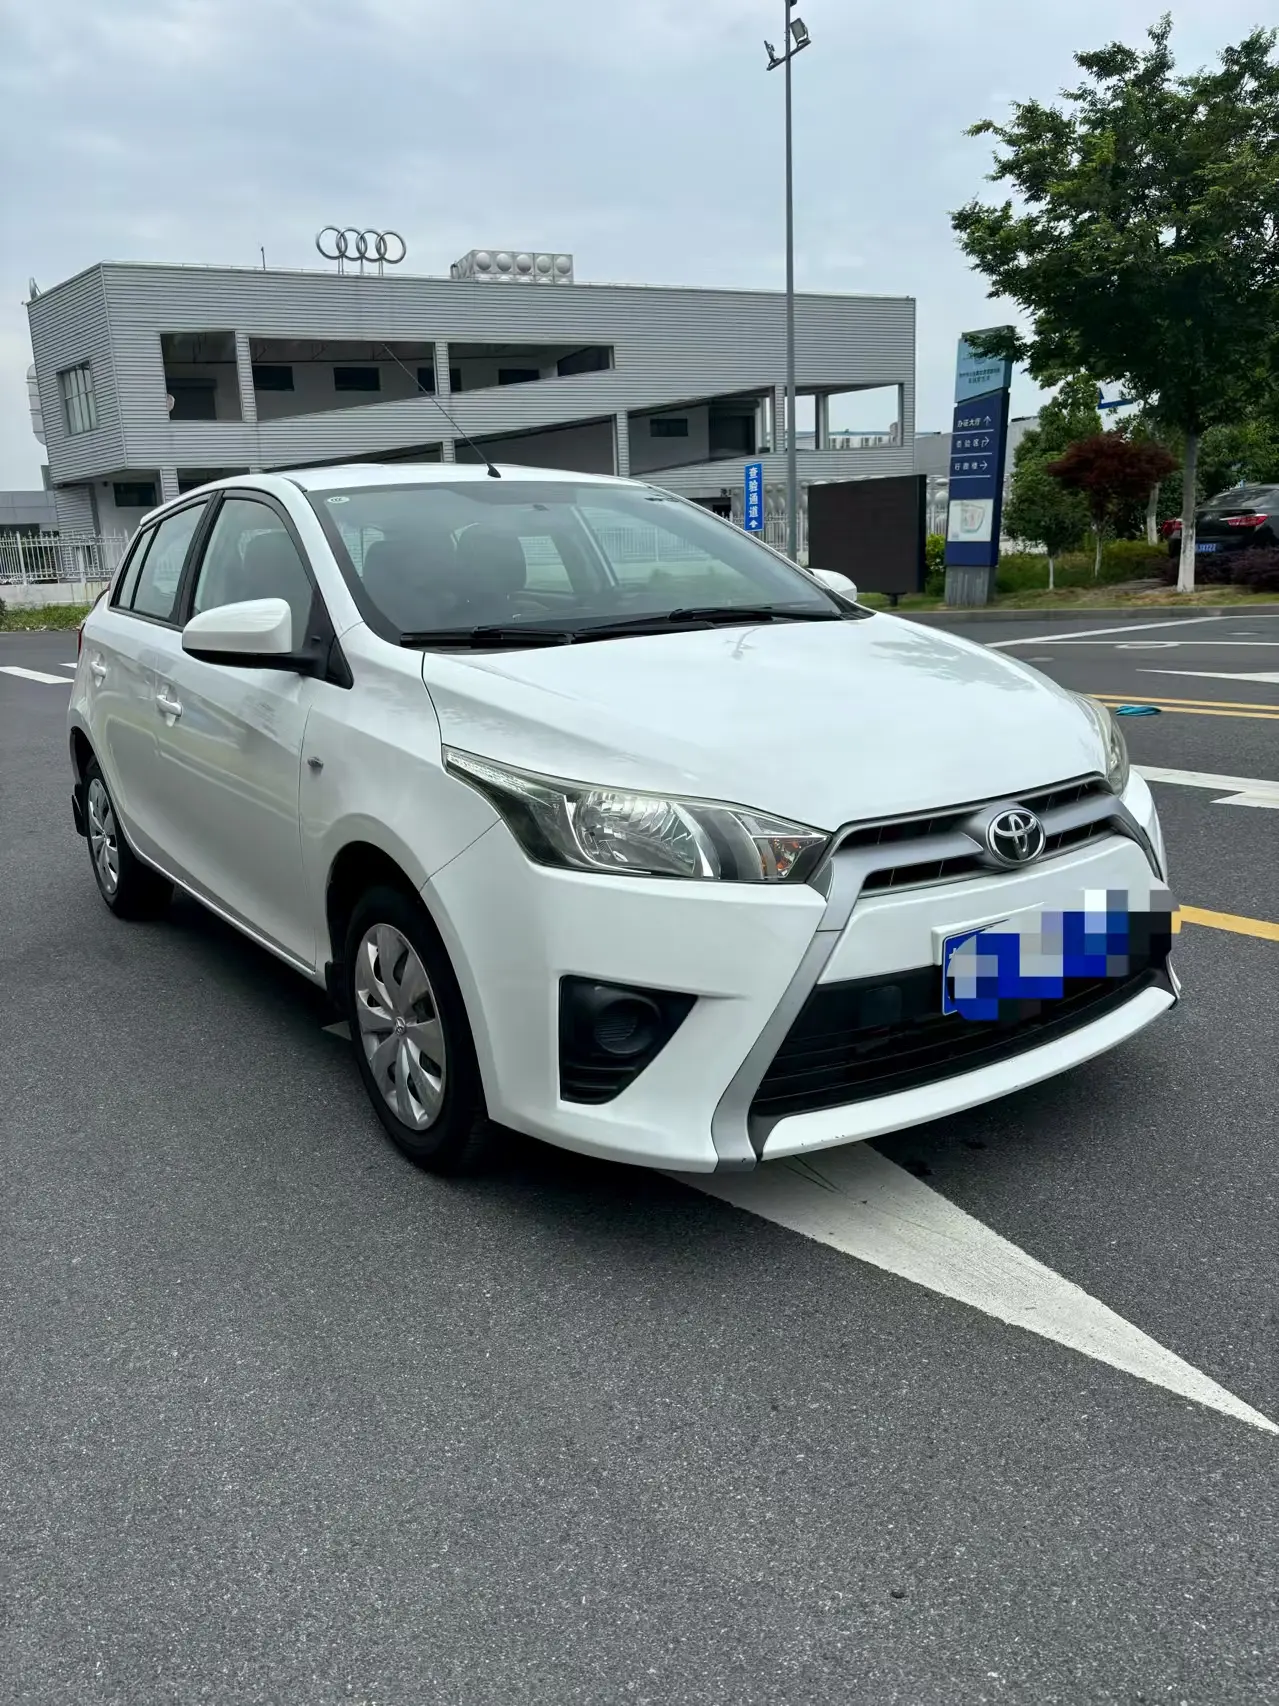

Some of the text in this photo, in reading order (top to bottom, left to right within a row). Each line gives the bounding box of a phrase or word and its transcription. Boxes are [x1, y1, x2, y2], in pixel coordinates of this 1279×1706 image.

[957, 418, 981, 428] 办证大厅
[748, 466, 758, 518] 查验通道
